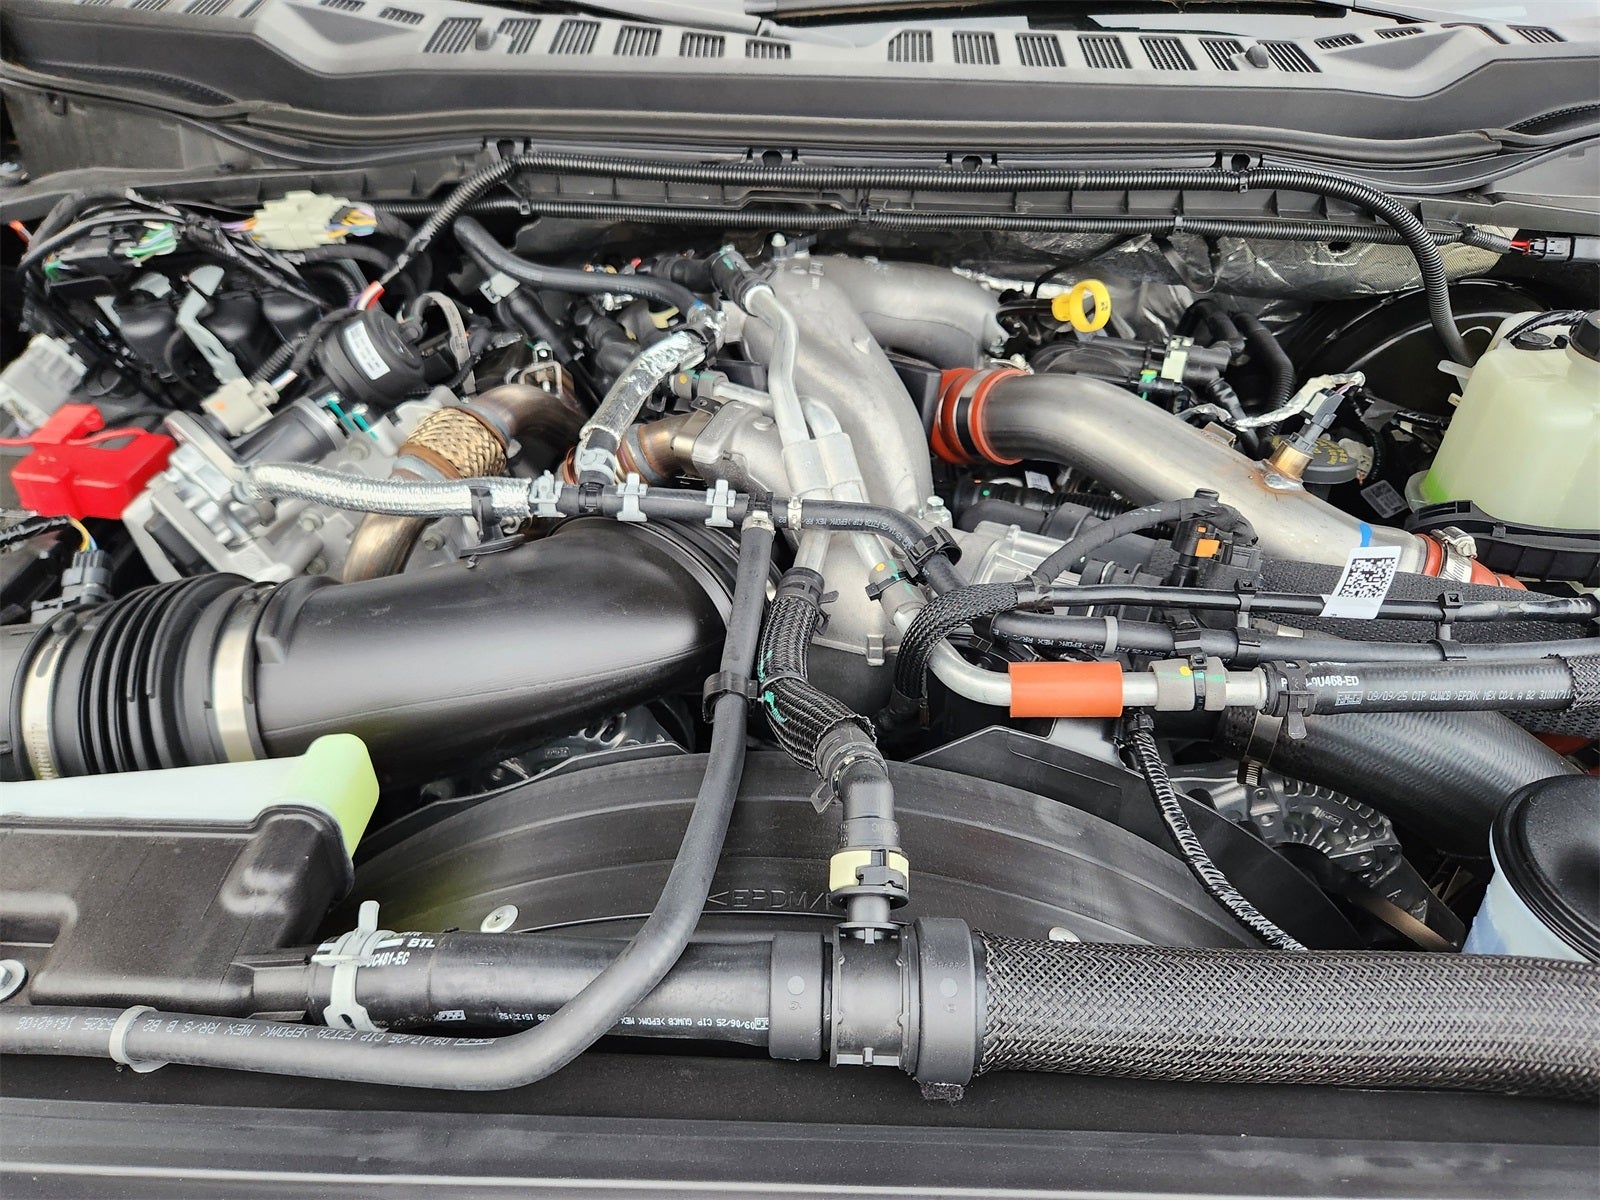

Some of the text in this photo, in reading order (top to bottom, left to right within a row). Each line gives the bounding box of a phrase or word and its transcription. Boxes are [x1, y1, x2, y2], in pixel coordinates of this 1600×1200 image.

[407, 938, 436, 948] BTL
[143, 1019, 162, 1033] B2
[620, 1016, 636, 1025] MEX
[697, 1017, 713, 1027] CIP
[716, 1018, 755, 1030] 09/06/25
[224, 1023, 257, 1037] MEX
[359, 1031, 387, 1043] CIP
